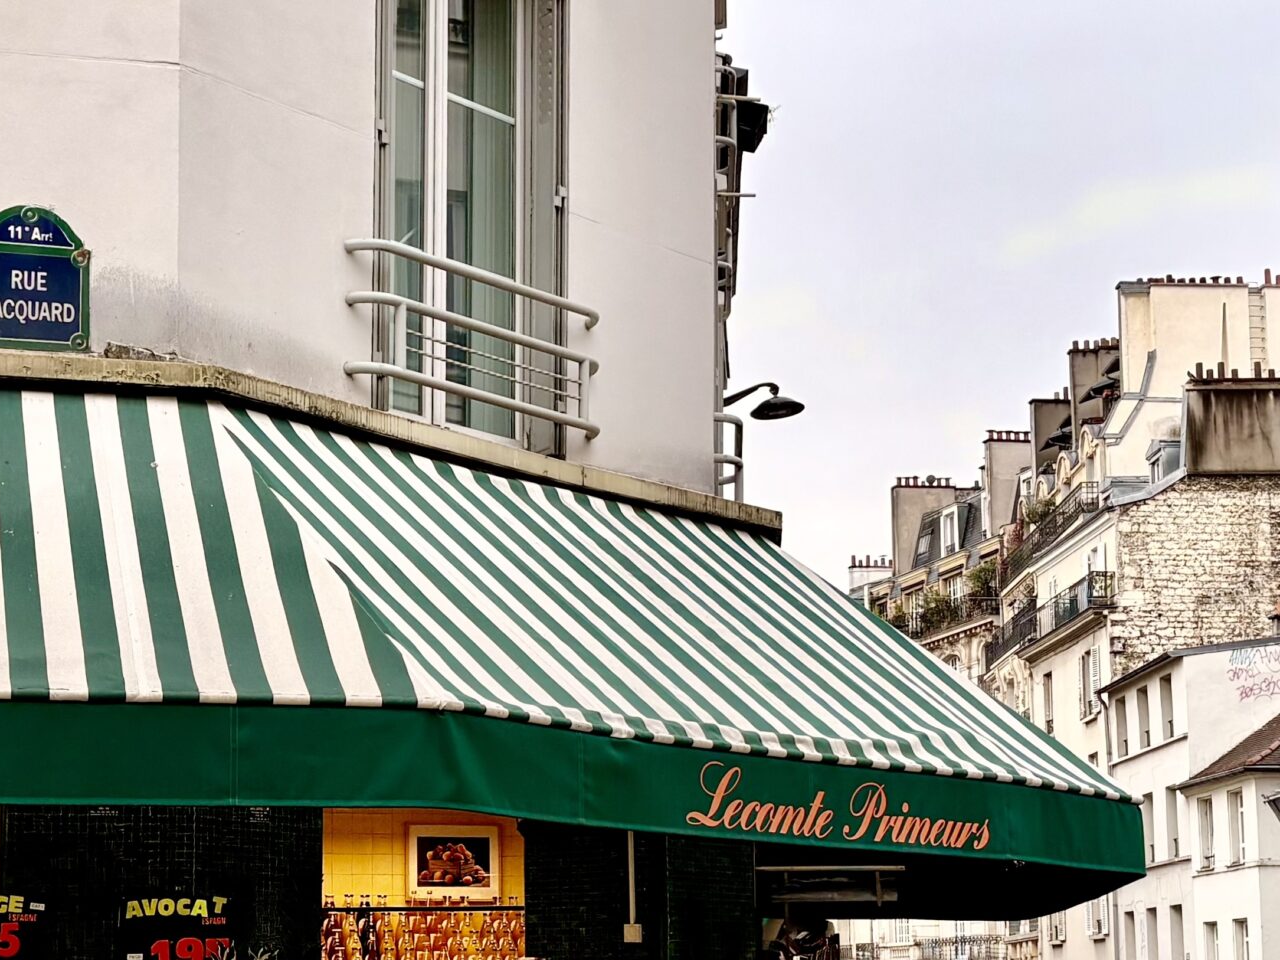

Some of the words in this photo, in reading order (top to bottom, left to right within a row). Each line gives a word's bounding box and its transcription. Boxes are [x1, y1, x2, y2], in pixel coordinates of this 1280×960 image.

[11, 270, 48, 291] RUE
[685, 760, 834, 838] Lecomte
[842, 782, 990, 849] Primeurs
[126, 896, 227, 919] AVOCAT
